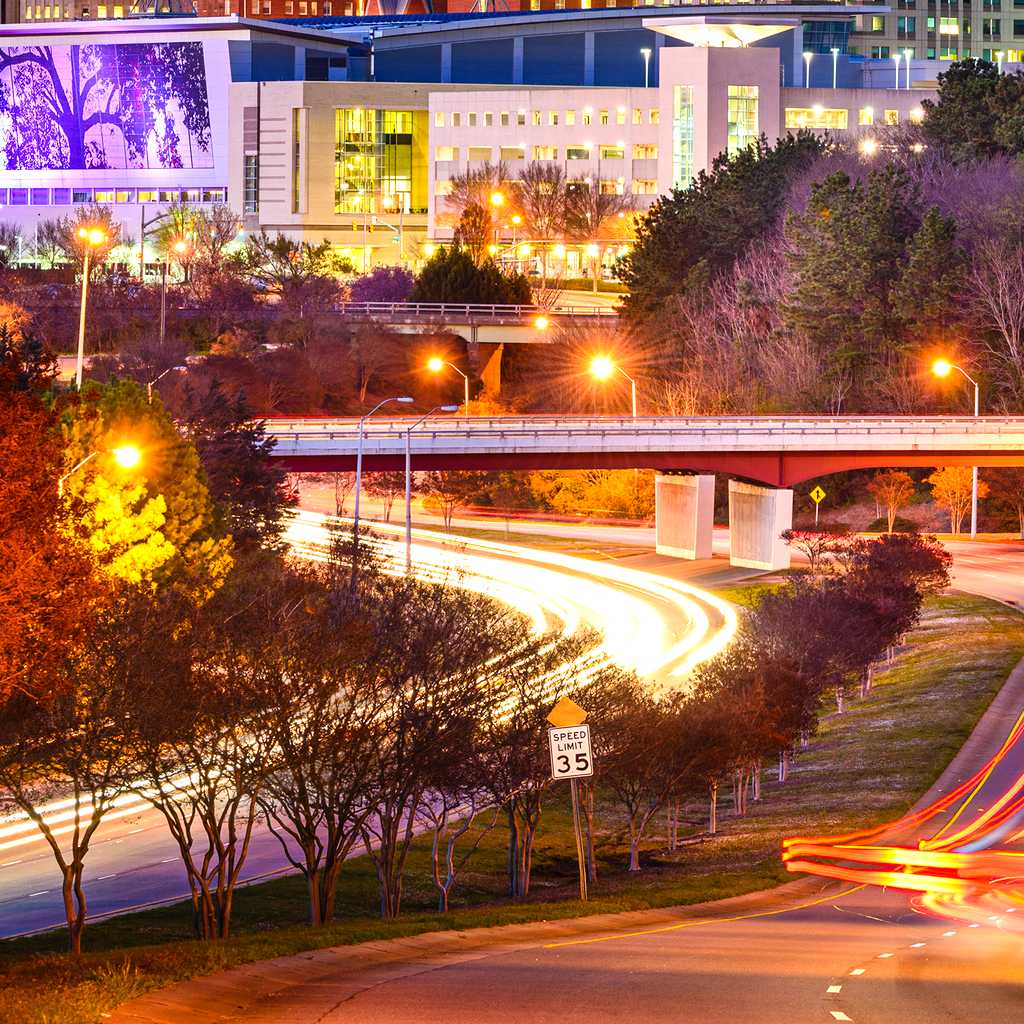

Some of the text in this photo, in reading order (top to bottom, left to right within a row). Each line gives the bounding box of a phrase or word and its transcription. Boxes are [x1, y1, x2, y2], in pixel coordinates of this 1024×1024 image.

[553, 730, 587, 742] SPEED
[557, 741, 583, 752] LIMIT
[557, 753, 589, 773] 35
